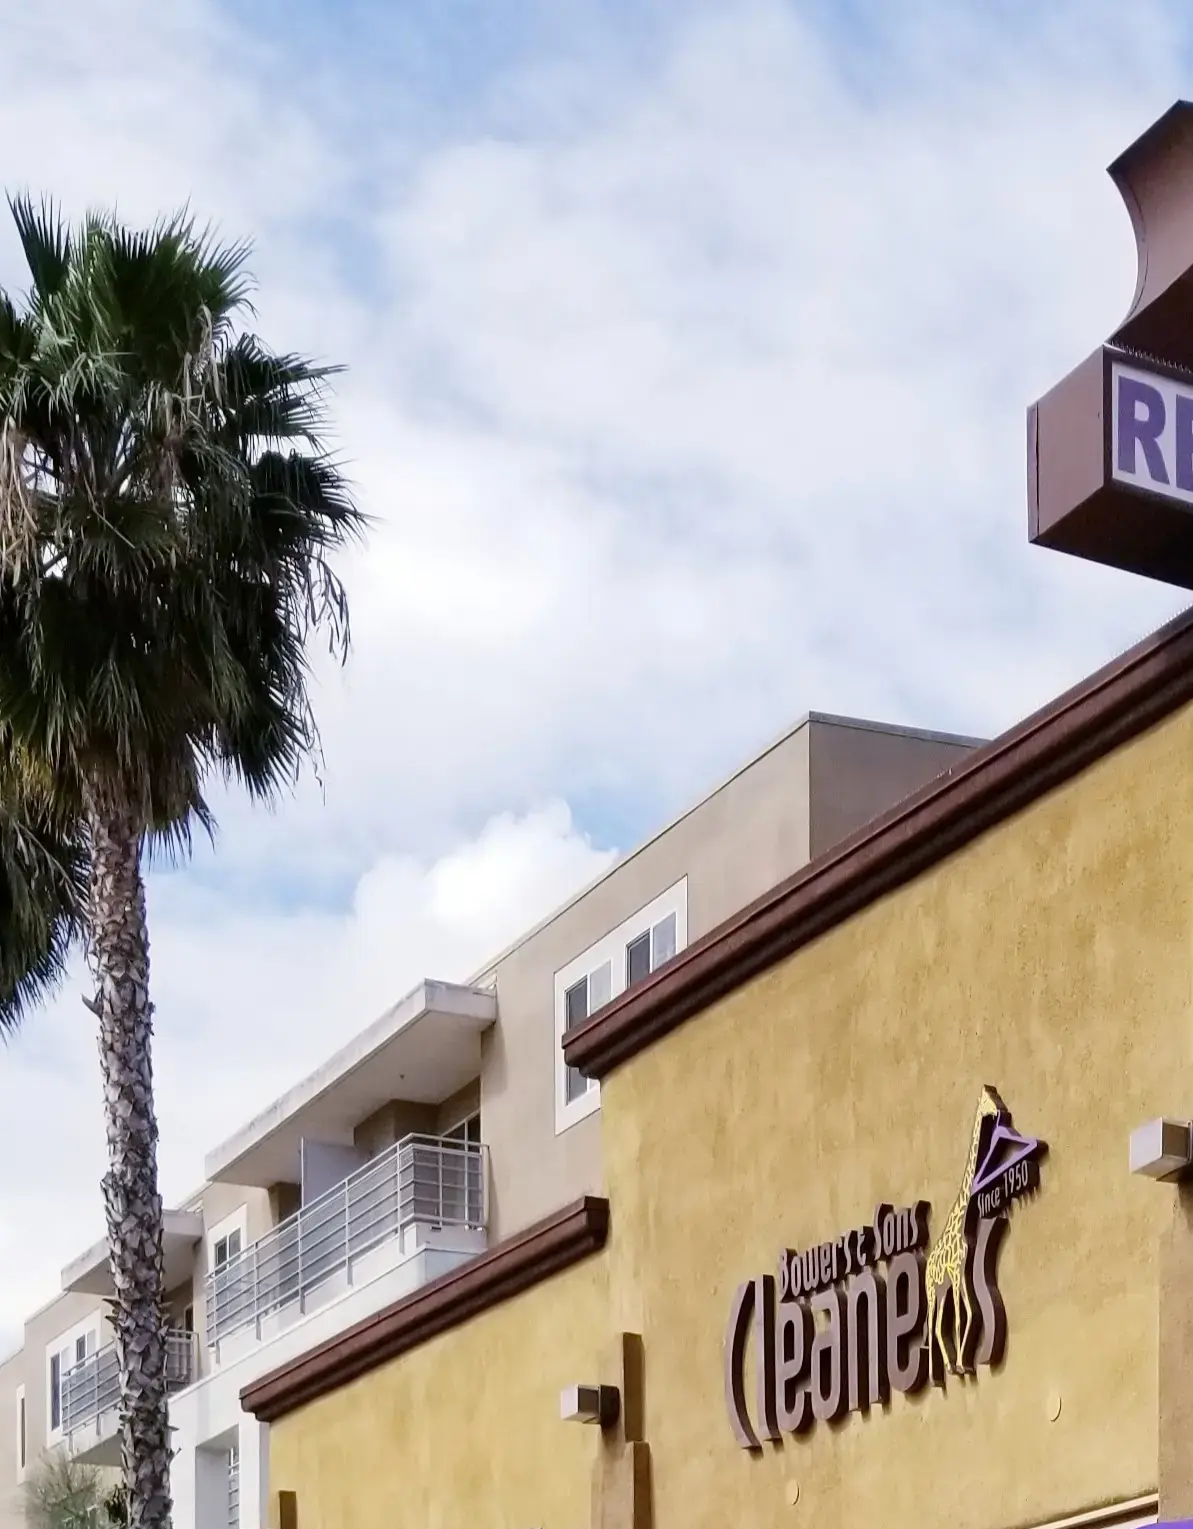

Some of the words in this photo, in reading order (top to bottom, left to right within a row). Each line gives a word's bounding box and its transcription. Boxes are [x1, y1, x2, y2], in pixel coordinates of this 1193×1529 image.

[977, 1185, 1001, 1217] Since
[1002, 1159, 1030, 1199] 1950
[872, 1201, 919, 1261] Sons
